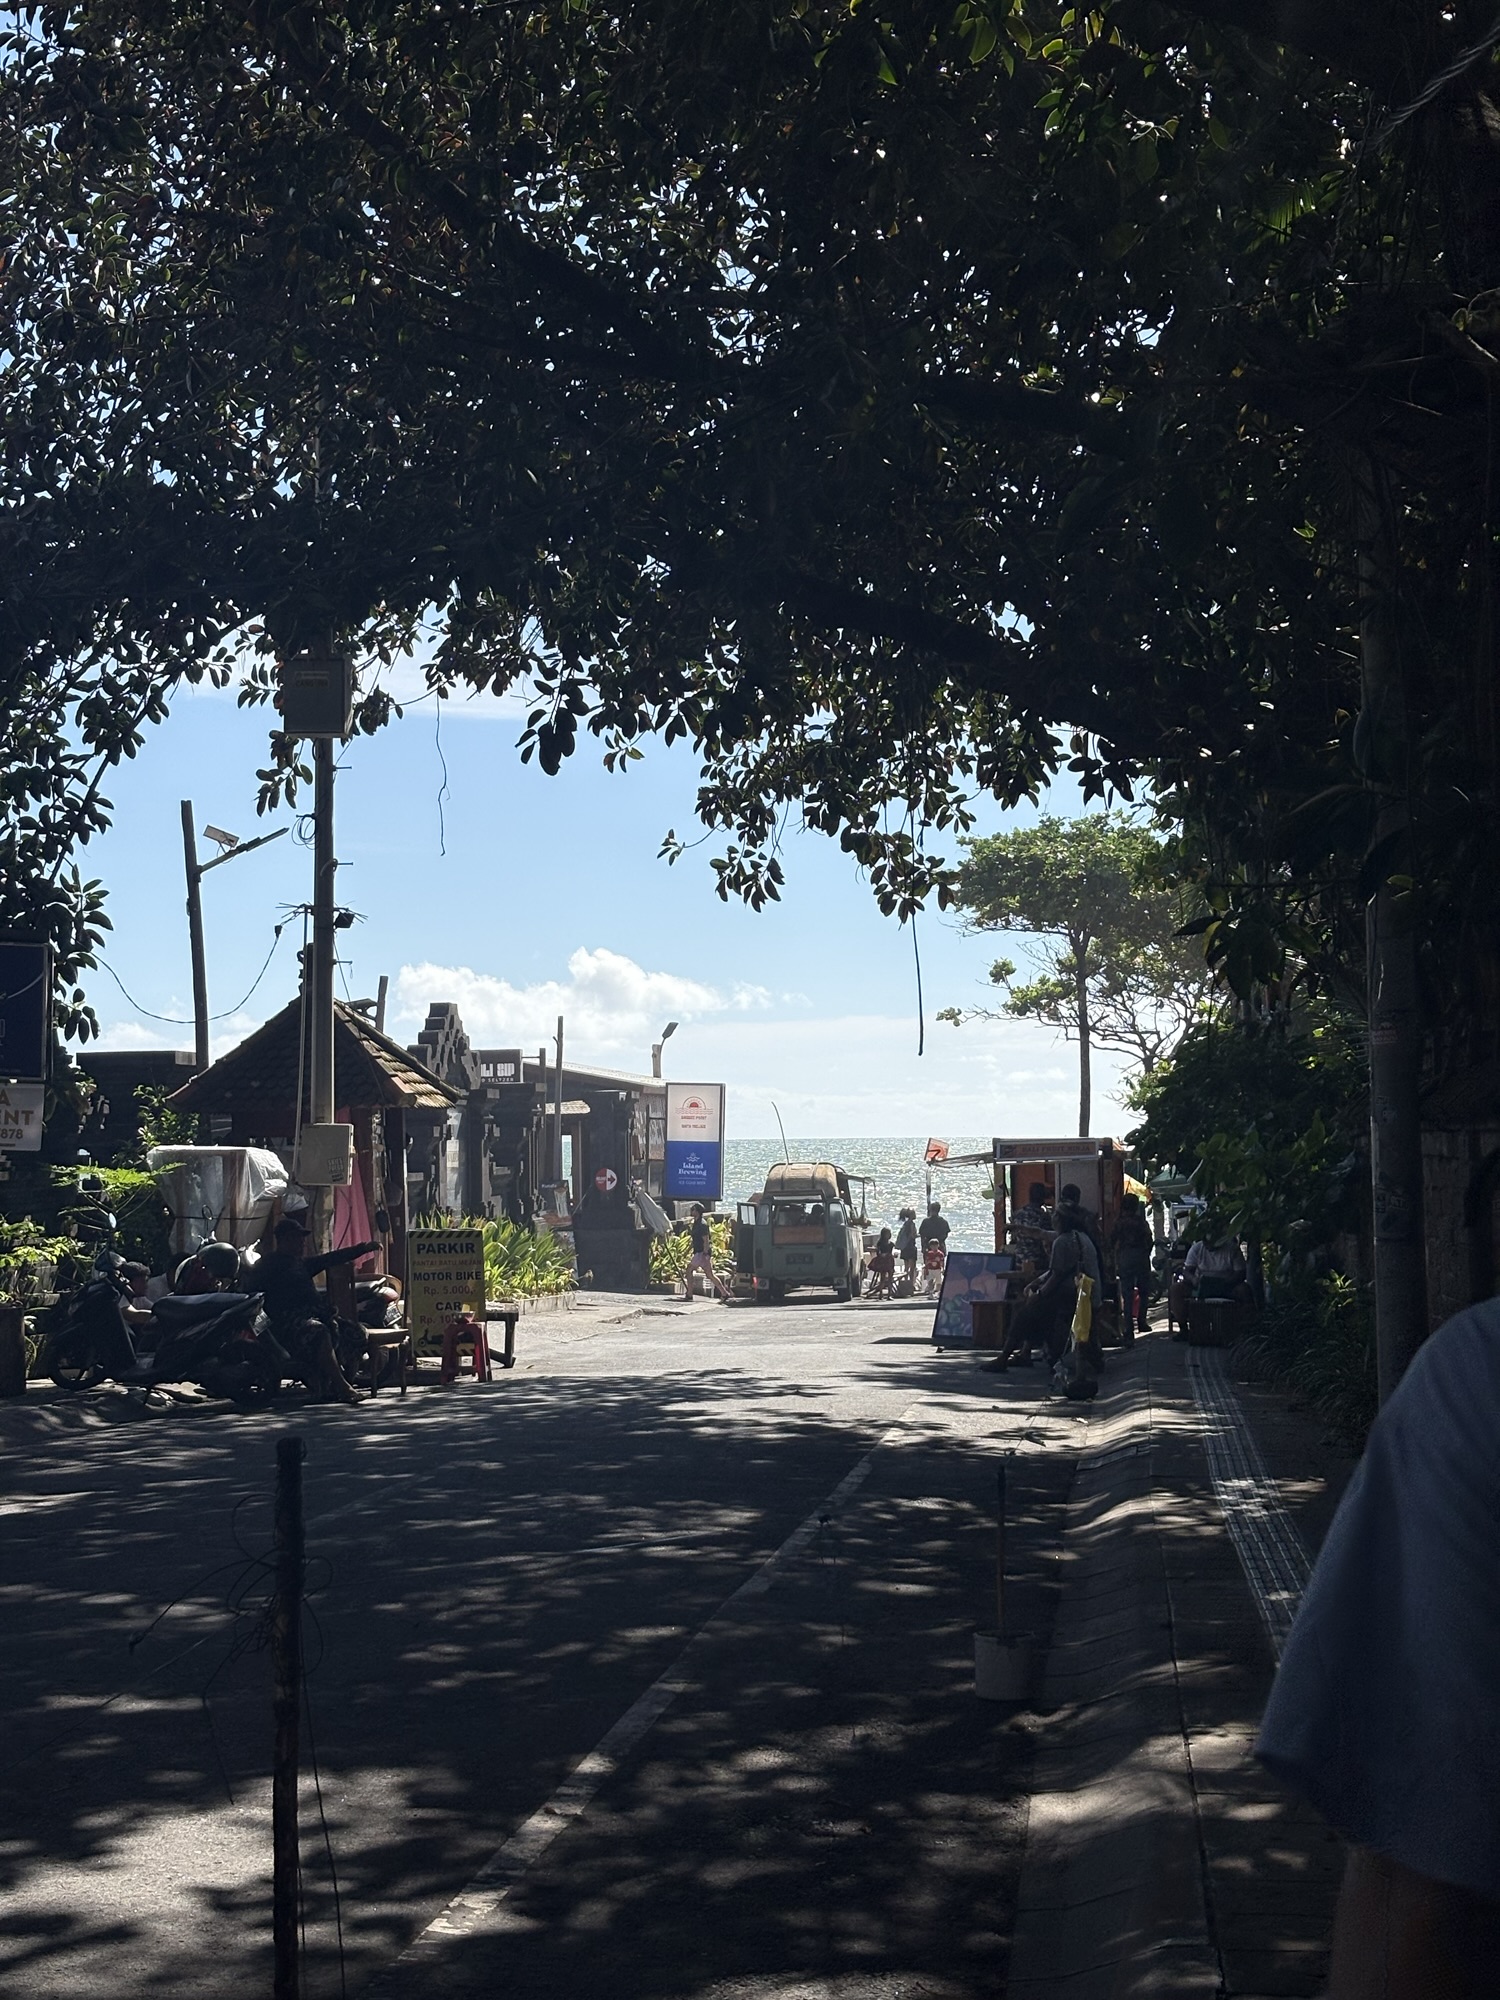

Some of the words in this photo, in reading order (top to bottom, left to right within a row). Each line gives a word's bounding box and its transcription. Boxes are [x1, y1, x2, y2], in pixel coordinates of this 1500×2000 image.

[0, 1110, 34, 1126] NT
[0, 1128, 24, 1140] 878
[678, 1168, 707, 1177] Brewing
[416, 1242, 476, 1255] PARKIR
[413, 1271, 452, 1281] MOTOR
[455, 1271, 482, 1281] BIKE
[423, 1286, 439, 1297] Rp.
[435, 1301, 462, 1312] CAR
[419, 1315, 435, 1325] Rp.
